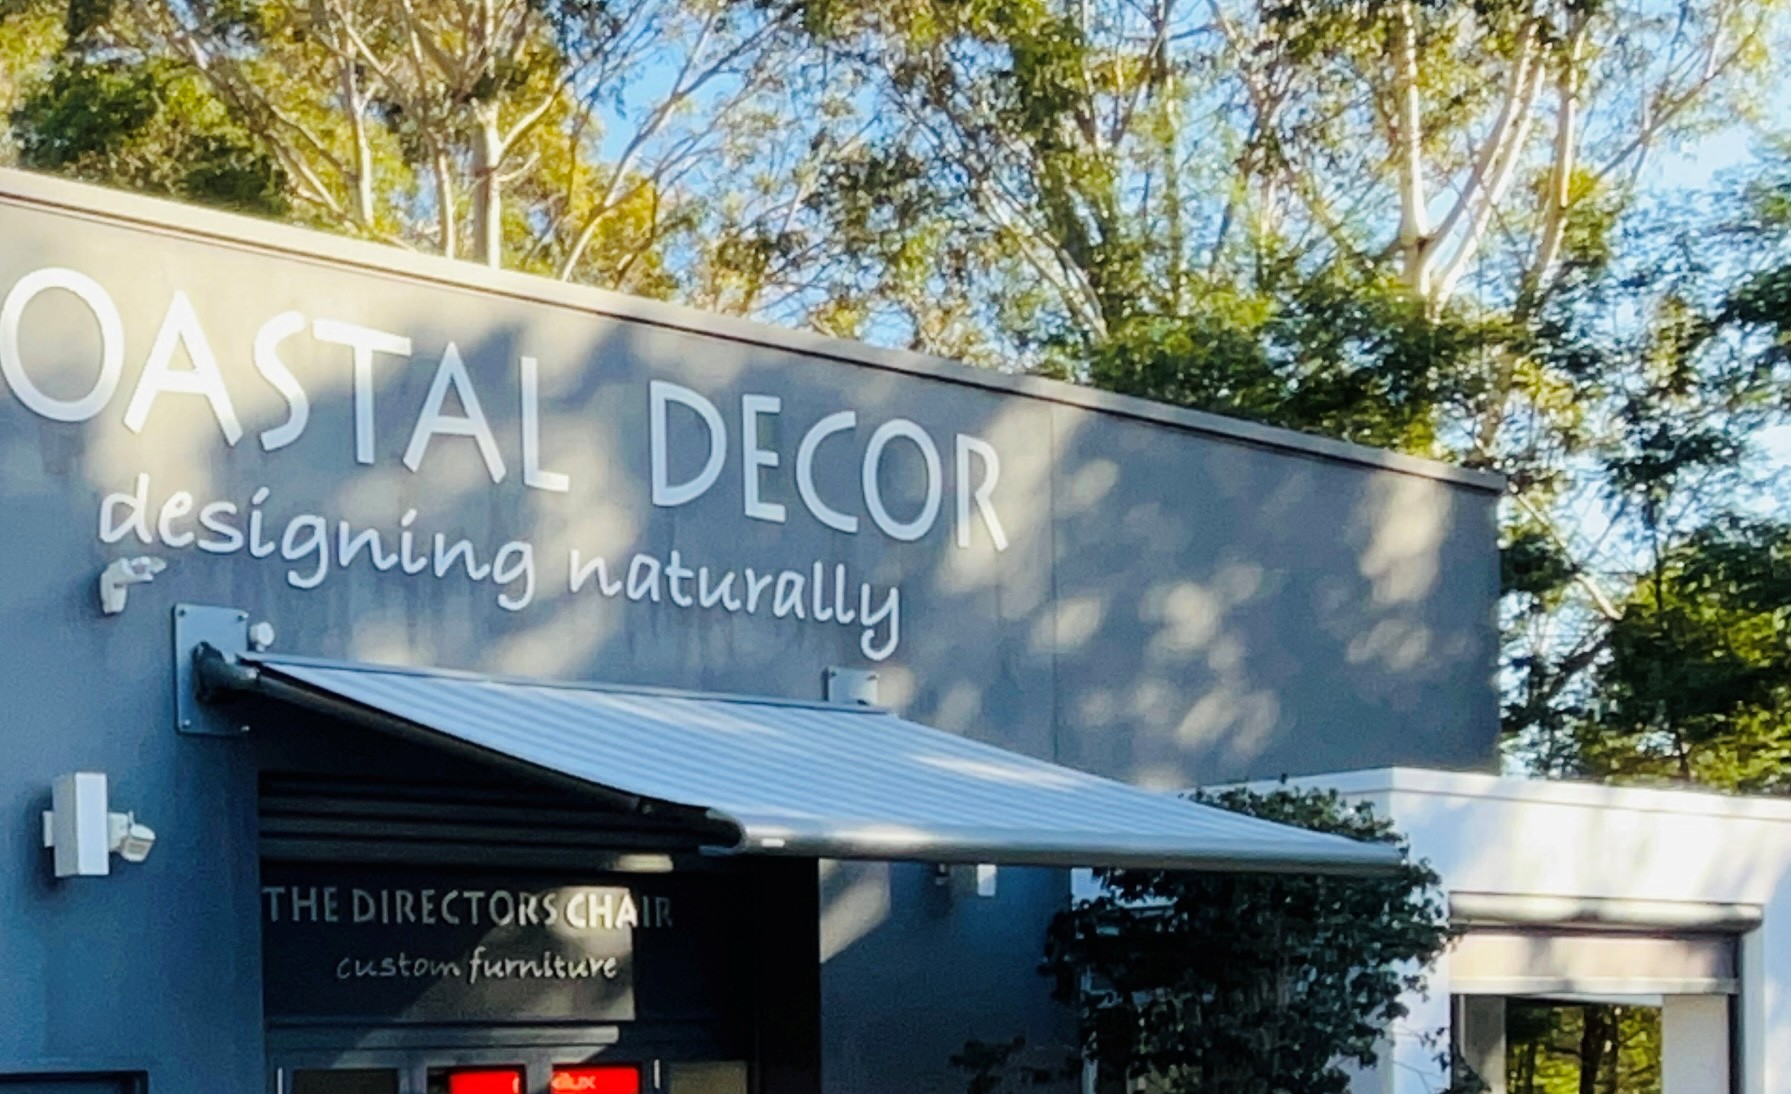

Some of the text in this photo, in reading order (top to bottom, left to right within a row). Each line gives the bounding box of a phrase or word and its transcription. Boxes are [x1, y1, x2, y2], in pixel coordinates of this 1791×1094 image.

[650, 380, 1007, 552] DECOR
[99, 473, 899, 661] designing naturally
[262, 887, 673, 928] THE DIRECTORS CHAIR
[337, 946, 618, 984] custom furniture
